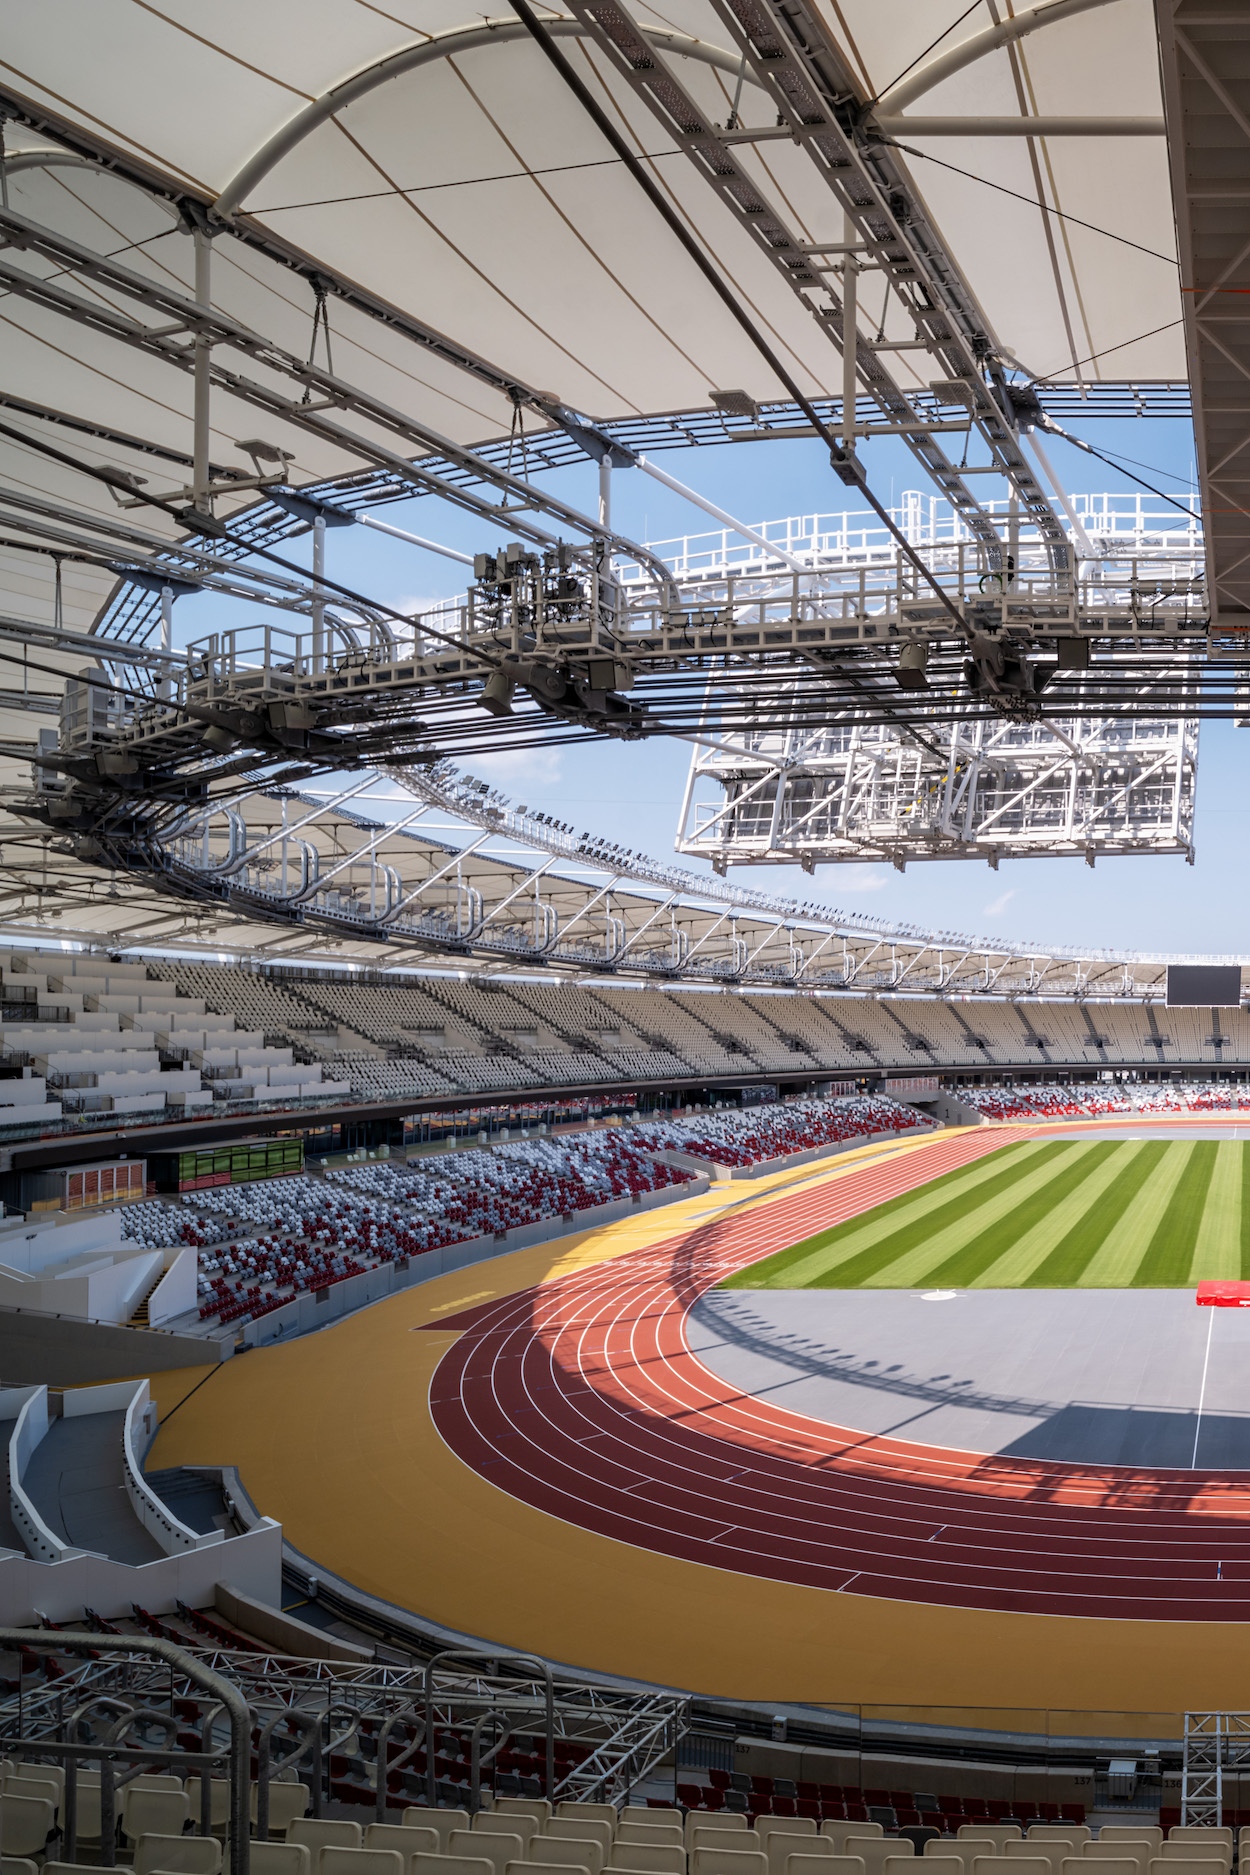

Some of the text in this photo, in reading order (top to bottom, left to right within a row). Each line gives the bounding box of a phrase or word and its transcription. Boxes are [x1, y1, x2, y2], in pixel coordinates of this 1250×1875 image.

[735, 1745, 751, 1754] 137
[1074, 1777, 1091, 1785] 137
[1164, 1780, 1182, 1788] 136
